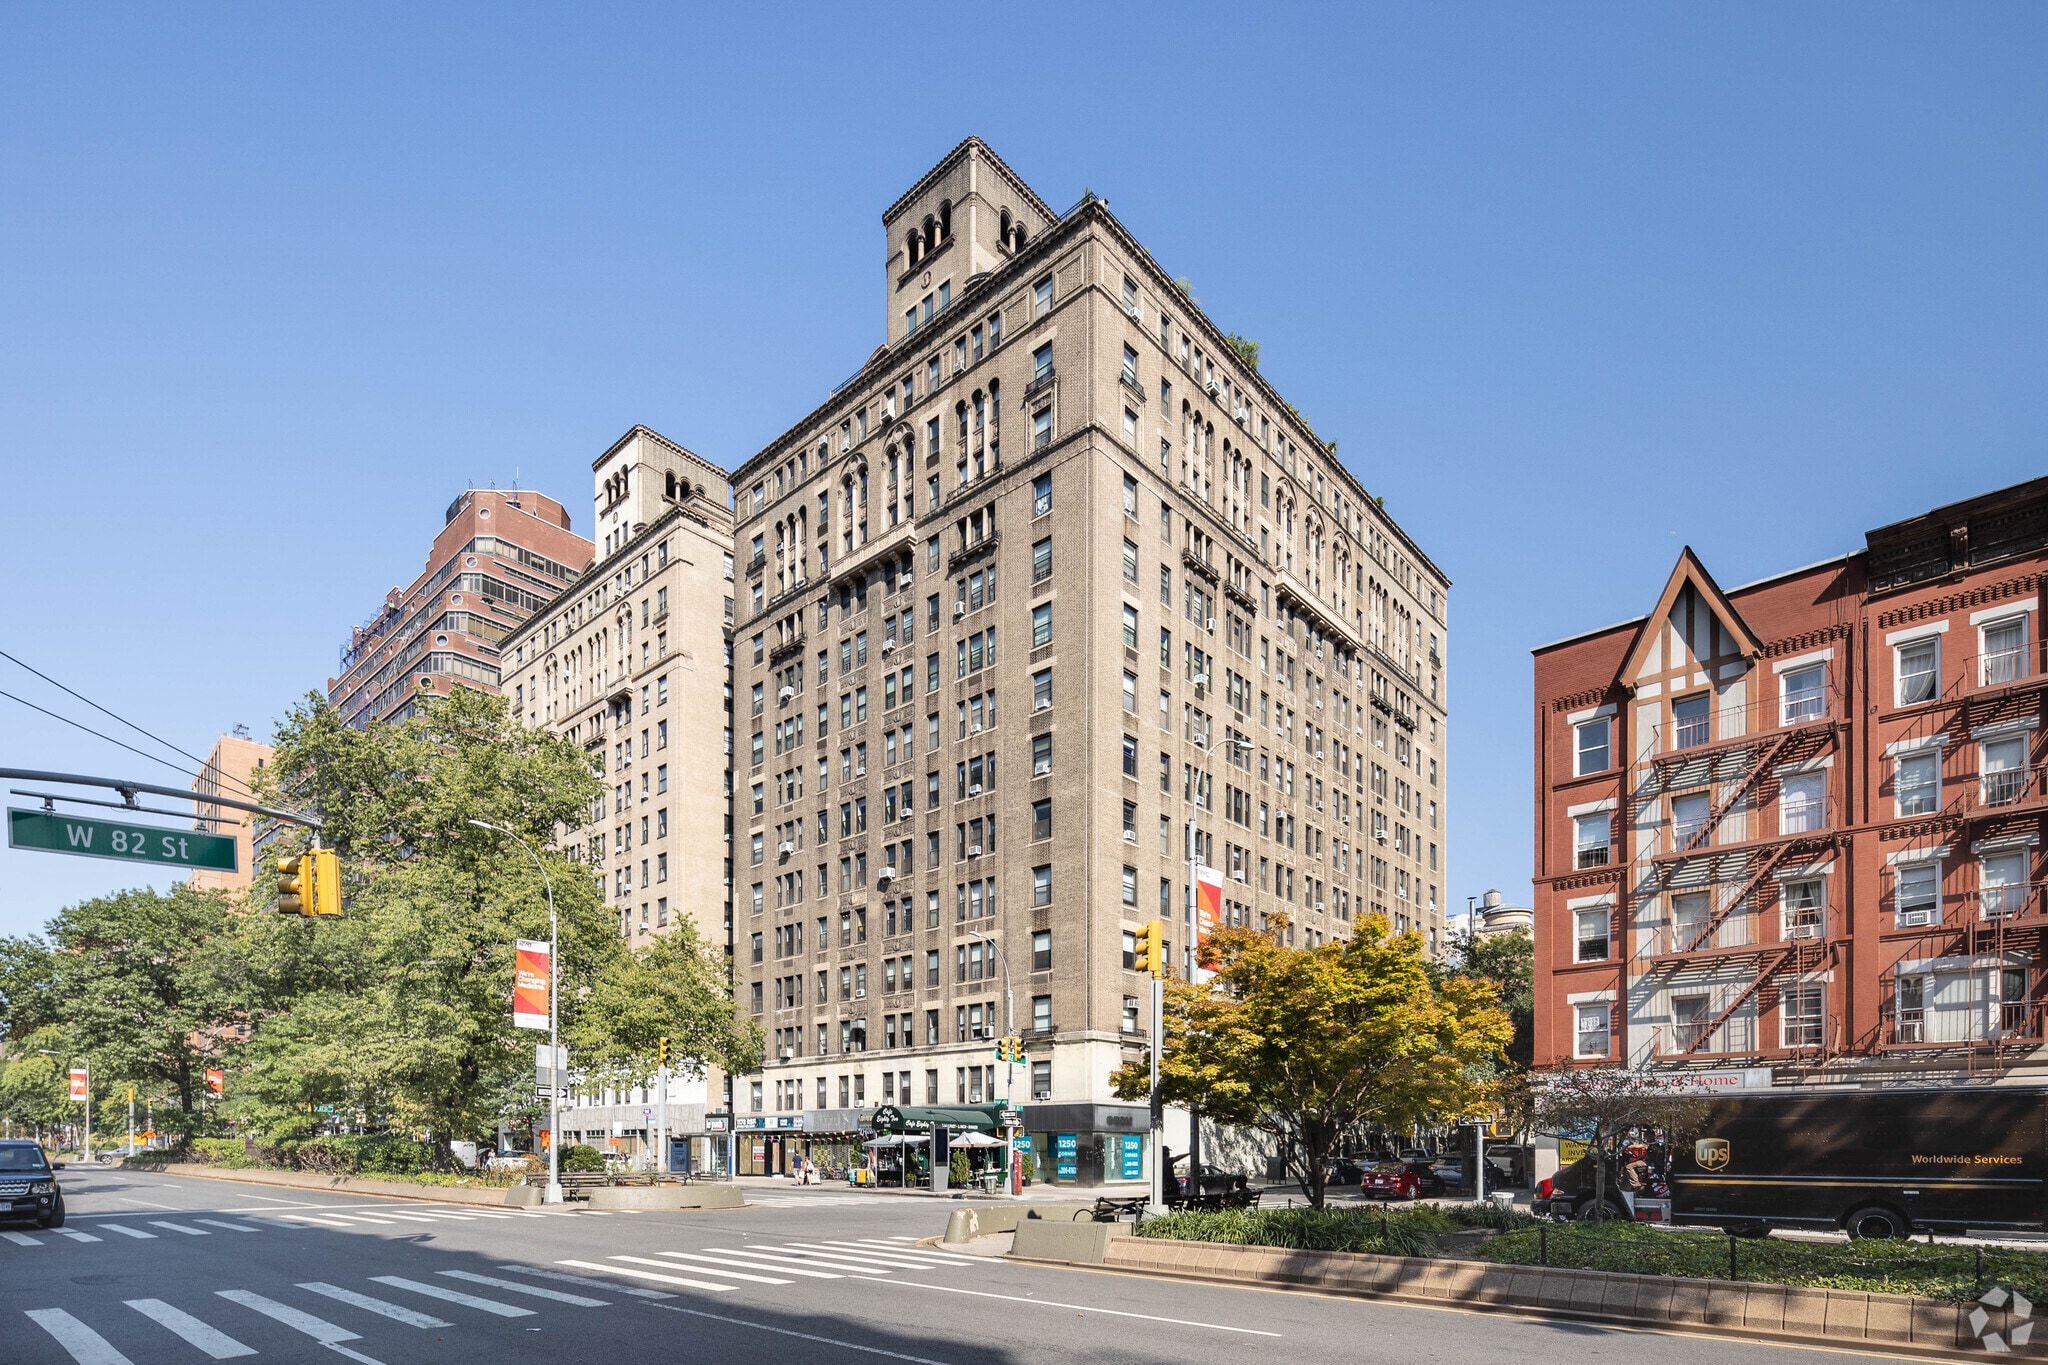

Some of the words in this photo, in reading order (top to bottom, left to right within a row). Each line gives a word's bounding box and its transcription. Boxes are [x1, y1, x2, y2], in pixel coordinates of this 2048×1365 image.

[66, 824, 94, 848] W
[111, 830, 146, 855] 82
[162, 836, 189, 860] St
[1690, 1074, 1739, 1086] Home
[876, 1115, 890, 1124] Eighty
[916, 1120, 930, 1129] Eighty
[1014, 1140, 1030, 1148] 1250
[1058, 1140, 1076, 1148] 1250
[1125, 1141, 1138, 1150] 1250
[1699, 1148, 1727, 1166] ups
[1911, 1154, 1971, 1164] Worldwide
[1974, 1155, 2023, 1165] Services
